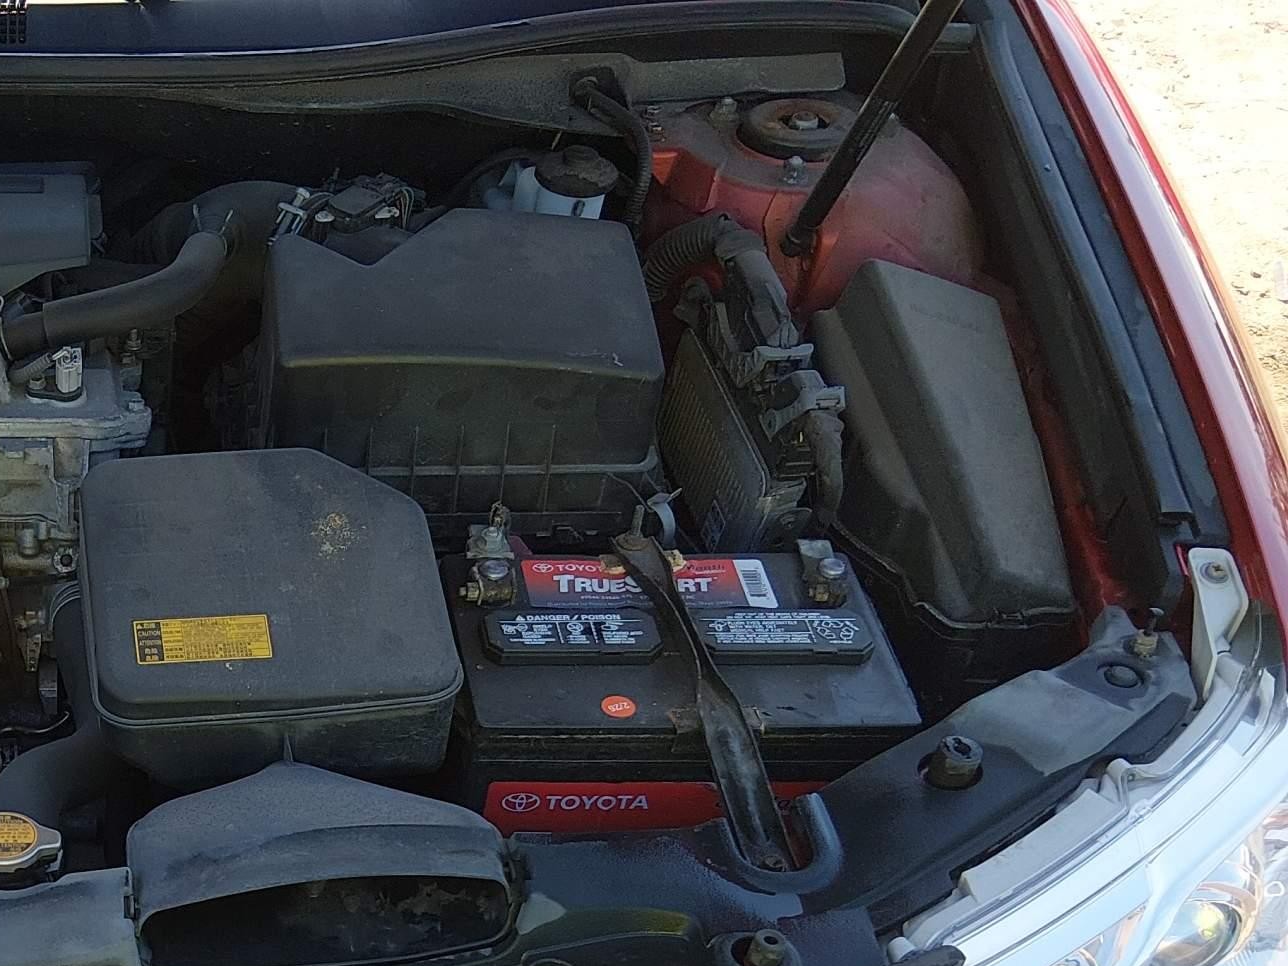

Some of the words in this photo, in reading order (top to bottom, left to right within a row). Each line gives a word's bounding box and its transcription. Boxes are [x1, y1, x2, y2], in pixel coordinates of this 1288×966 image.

[558, 564, 601, 572] TOYO
[553, 574, 712, 593] TRUESRT
[546, 795, 649, 810] TOYOTA
